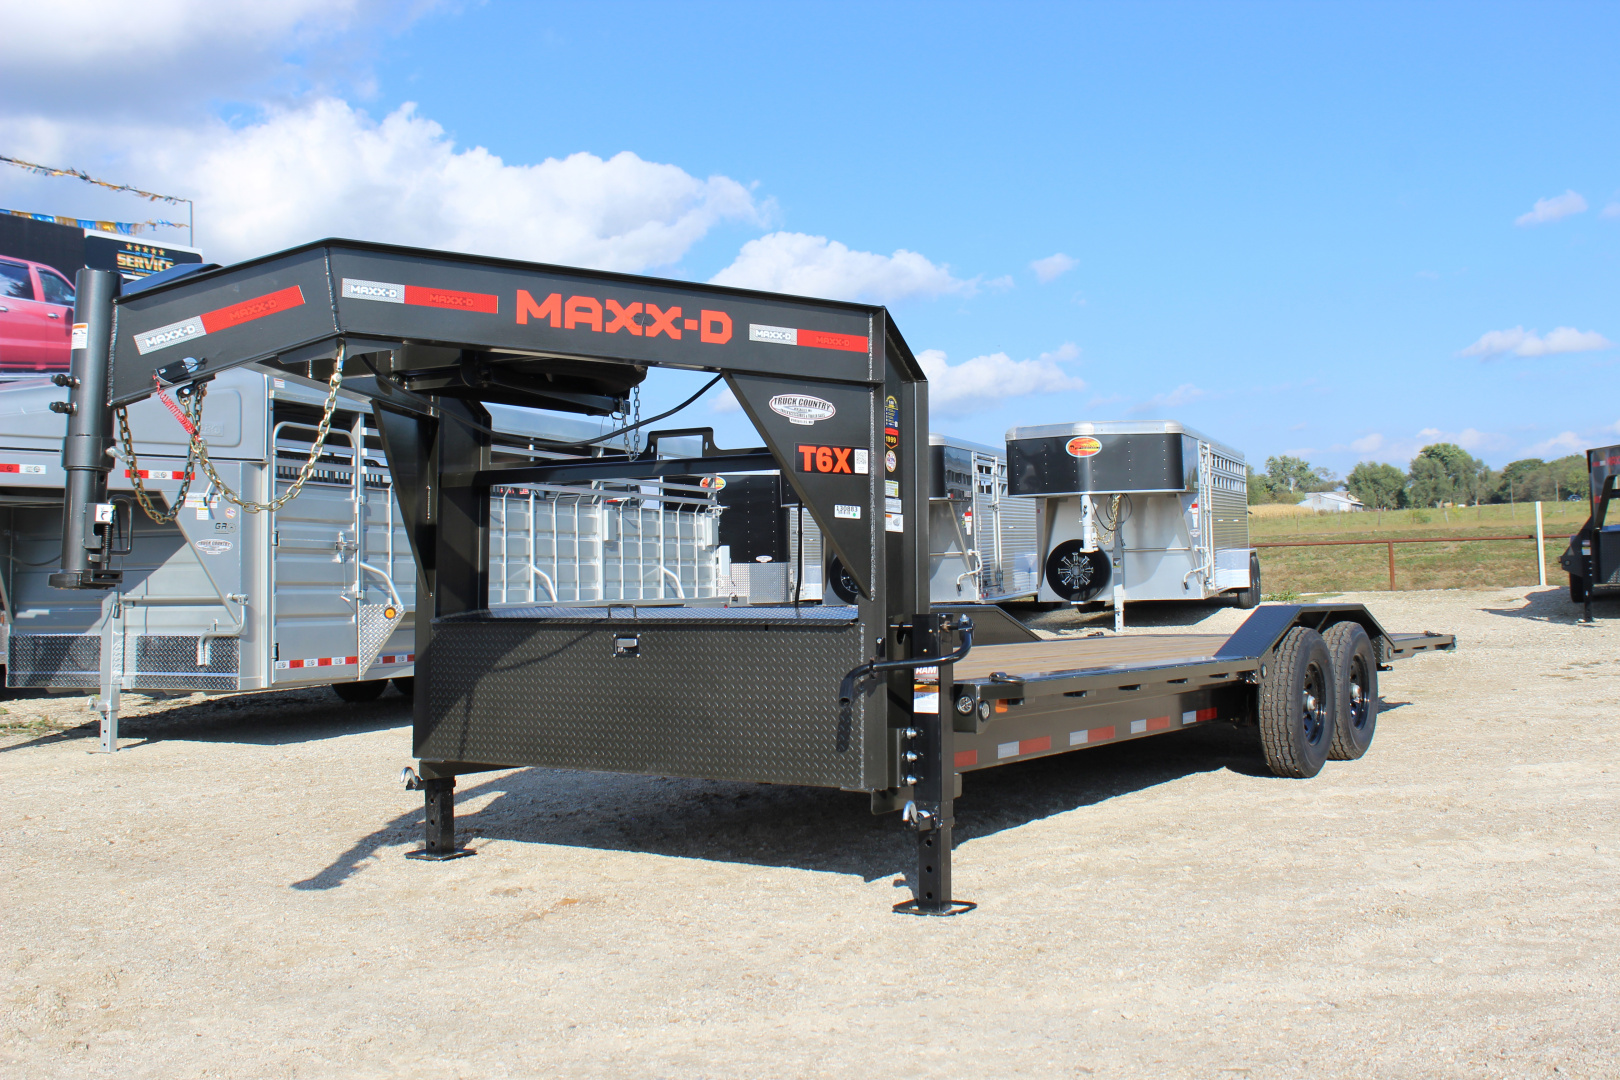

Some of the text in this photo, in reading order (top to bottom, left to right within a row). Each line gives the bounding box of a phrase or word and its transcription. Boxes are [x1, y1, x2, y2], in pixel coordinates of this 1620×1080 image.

[116, 252, 175, 272] SERVICE
[349, 284, 398, 298] MAXX-D
[429, 293, 474, 307] MAXX-D
[229, 299, 277, 321] MAXX-D
[516, 289, 733, 345] MAXX-D
[145, 324, 196, 348] MAXX-D
[755, 329, 791, 341] MAXX-D
[816, 336, 850, 346] MAXX-D
[773, 397, 797, 406] TRUCK
[798, 398, 831, 411] COUNTRY
[798, 445, 852, 474] T6X
